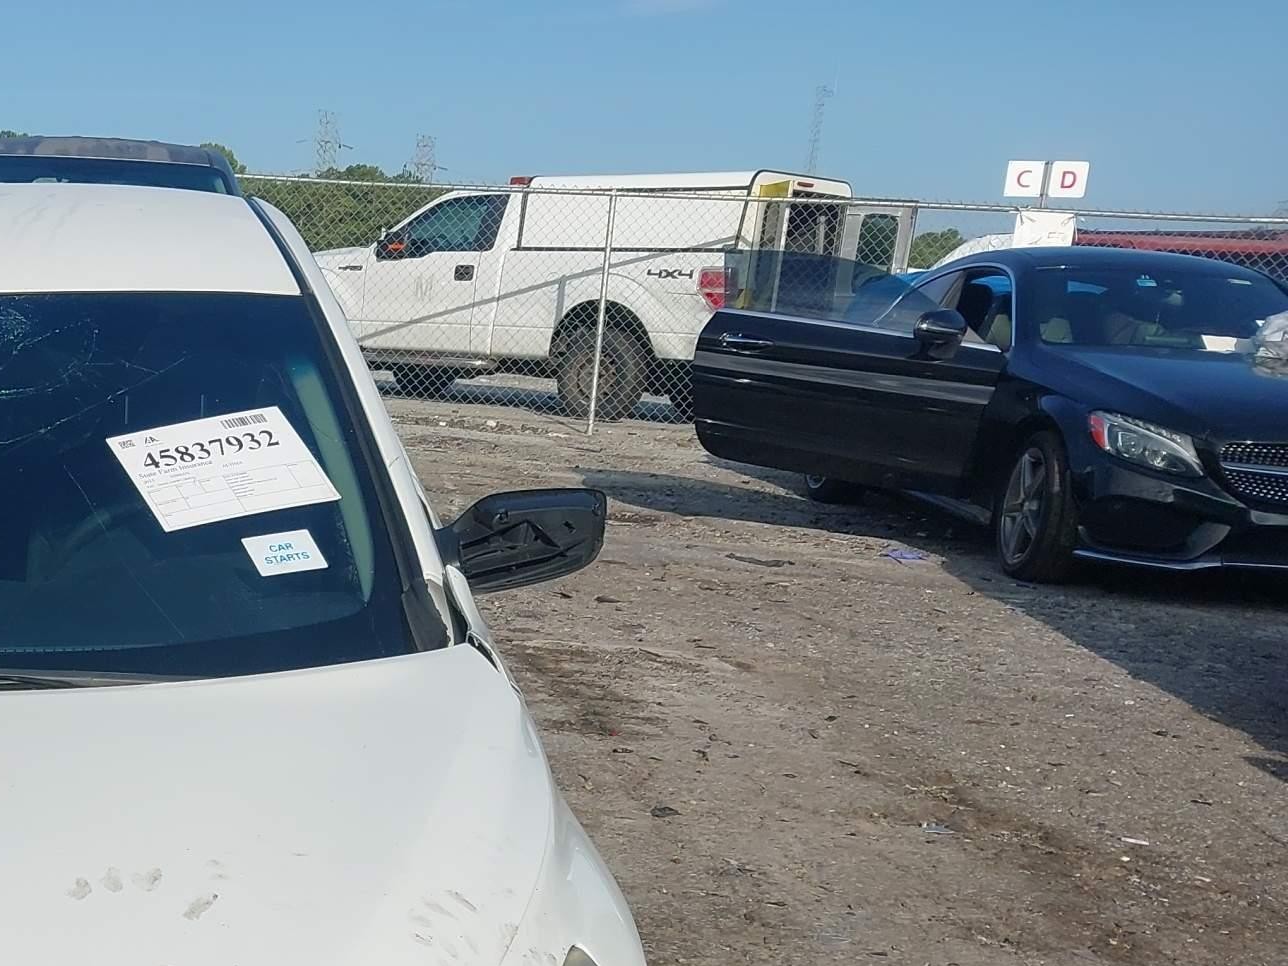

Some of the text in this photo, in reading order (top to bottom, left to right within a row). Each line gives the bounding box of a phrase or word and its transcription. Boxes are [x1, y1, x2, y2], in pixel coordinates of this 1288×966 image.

[1016, 169, 1033, 188] C
[1059, 170, 1077, 189] D
[143, 430, 280, 469] 45837932
[158, 466, 178, 475] Farm
[269, 542, 294, 553] CAR
[264, 551, 310, 565] STARTS
